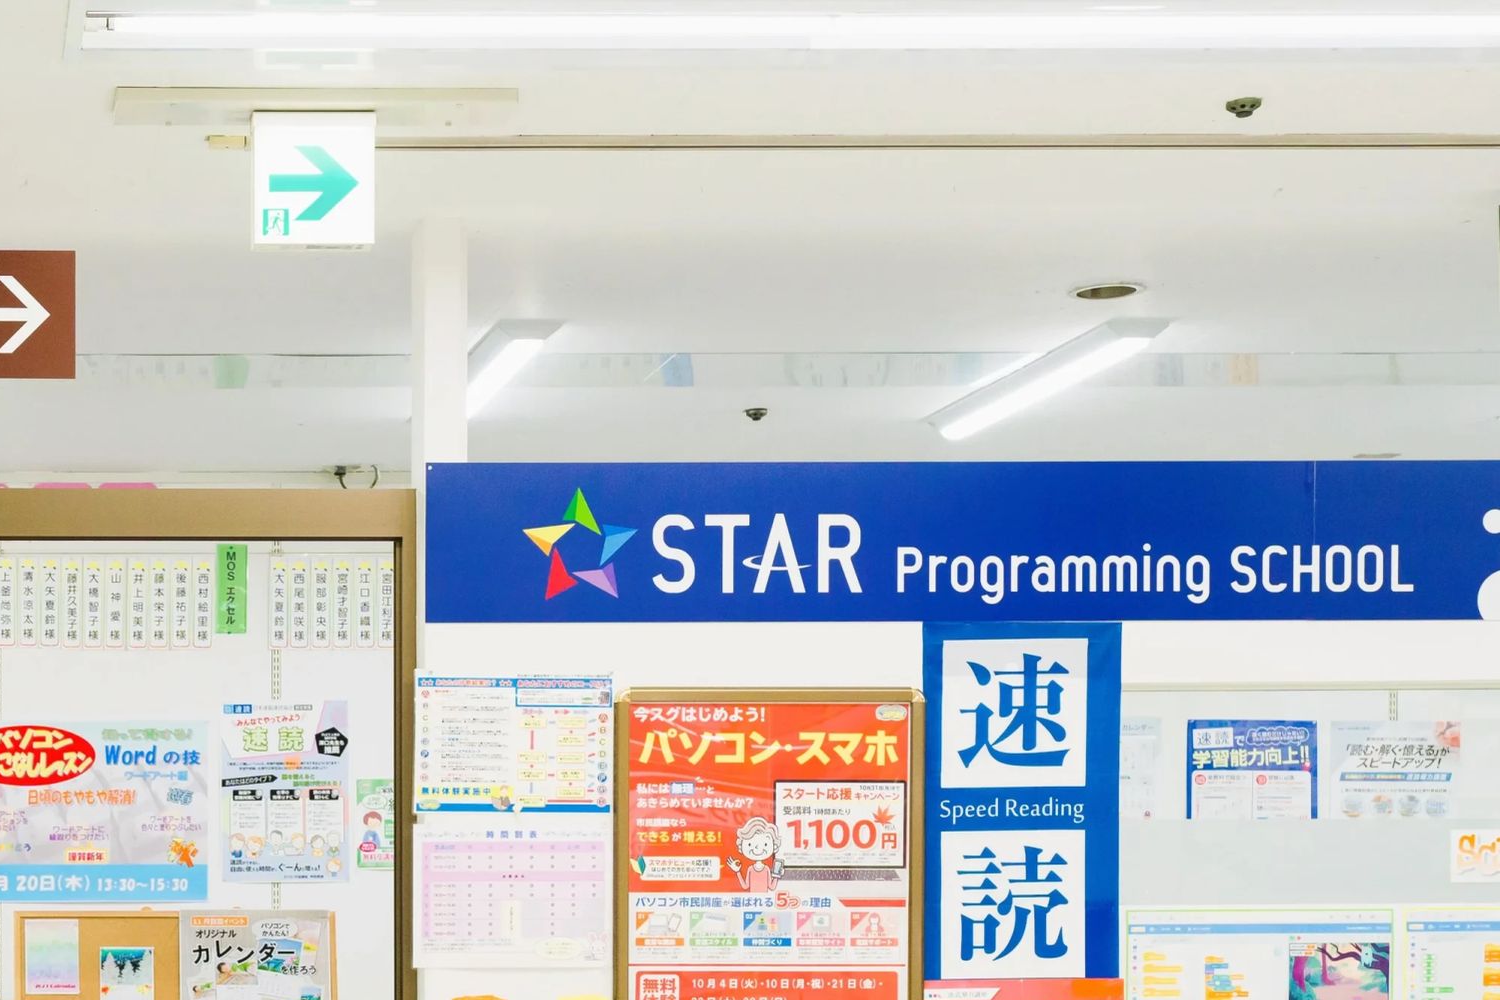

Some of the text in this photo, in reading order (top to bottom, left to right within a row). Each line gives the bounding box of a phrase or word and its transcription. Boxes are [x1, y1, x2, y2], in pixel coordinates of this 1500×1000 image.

[651, 513, 1414, 605] STAR Programming SCHOOL
[225, 552, 237, 625] MOS エクセル
[633, 706, 766, 722] 今スグはじめよう!
[105, 745, 201, 766] Word の技
[638, 728, 899, 767] パソコン・スマホ
[636, 797, 754, 809] あきらめていませんか?
[940, 797, 1085, 824] Speed Reading
[16, 874, 90, 893] 20日(木)
[196, 930, 237, 938] オリジナル
[193, 941, 295, 965] カレンダー
[281, 966, 317, 975] を作ろう
[643, 978, 677, 993] 無料
